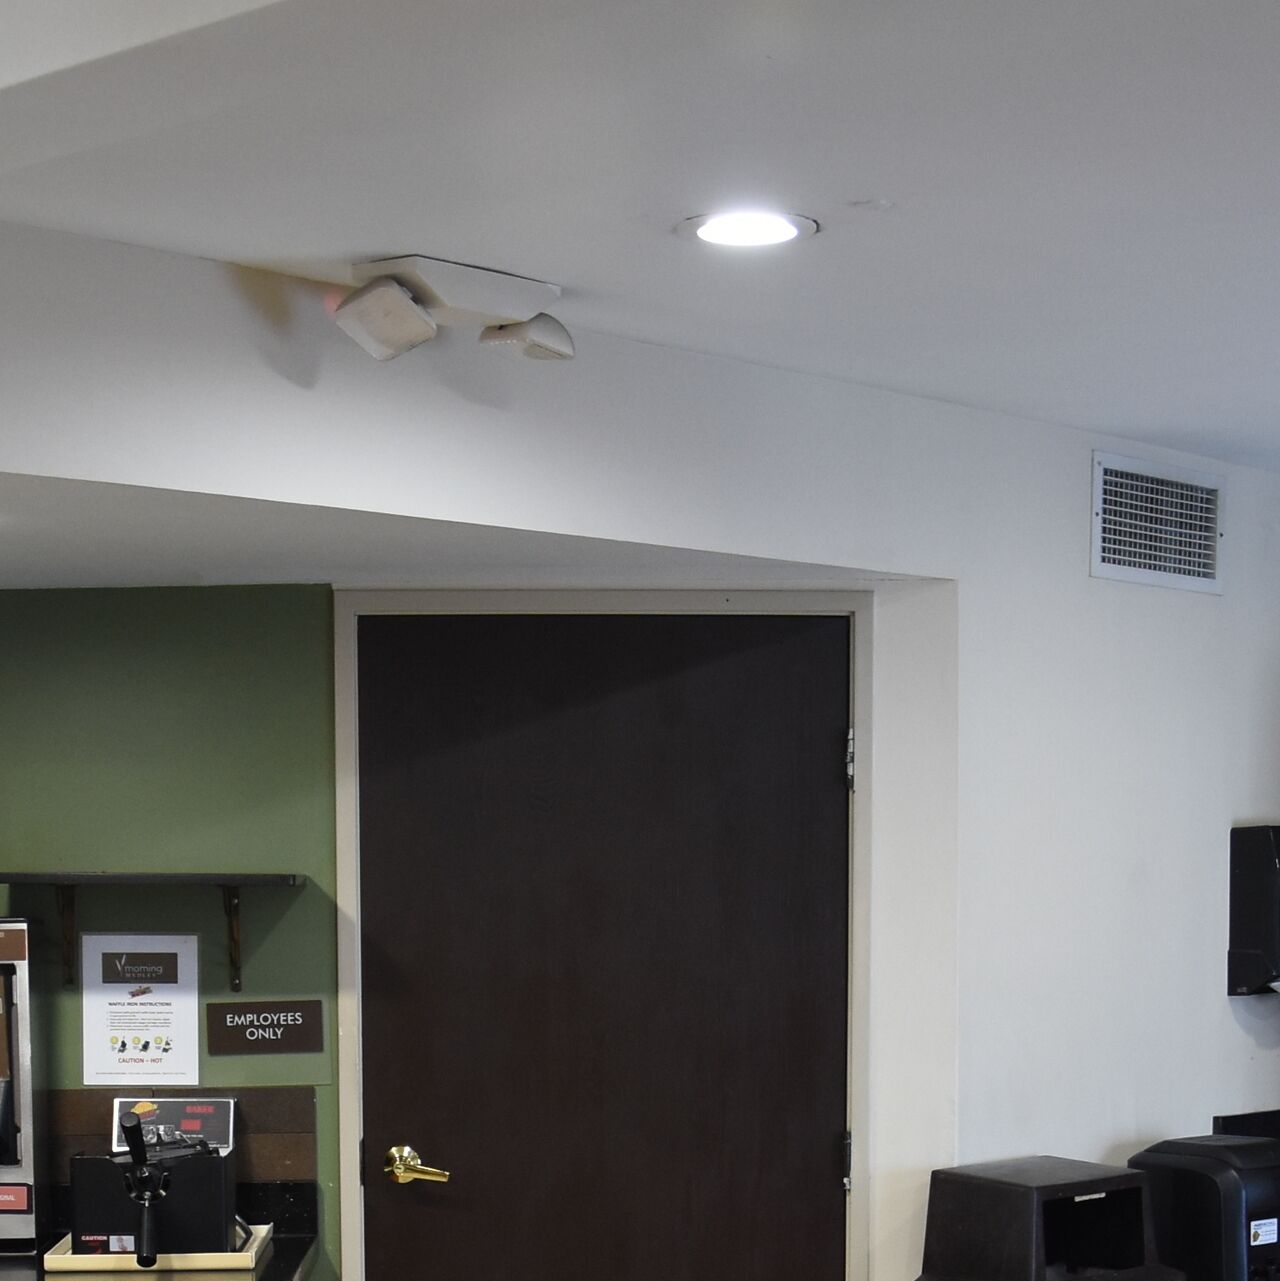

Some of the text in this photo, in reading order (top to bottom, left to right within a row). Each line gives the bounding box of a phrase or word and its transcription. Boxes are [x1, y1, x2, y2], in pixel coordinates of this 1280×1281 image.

[124, 963, 163, 974] morning
[226, 1012, 303, 1026] EMPLOYEES
[245, 1027, 284, 1040] ONLY
